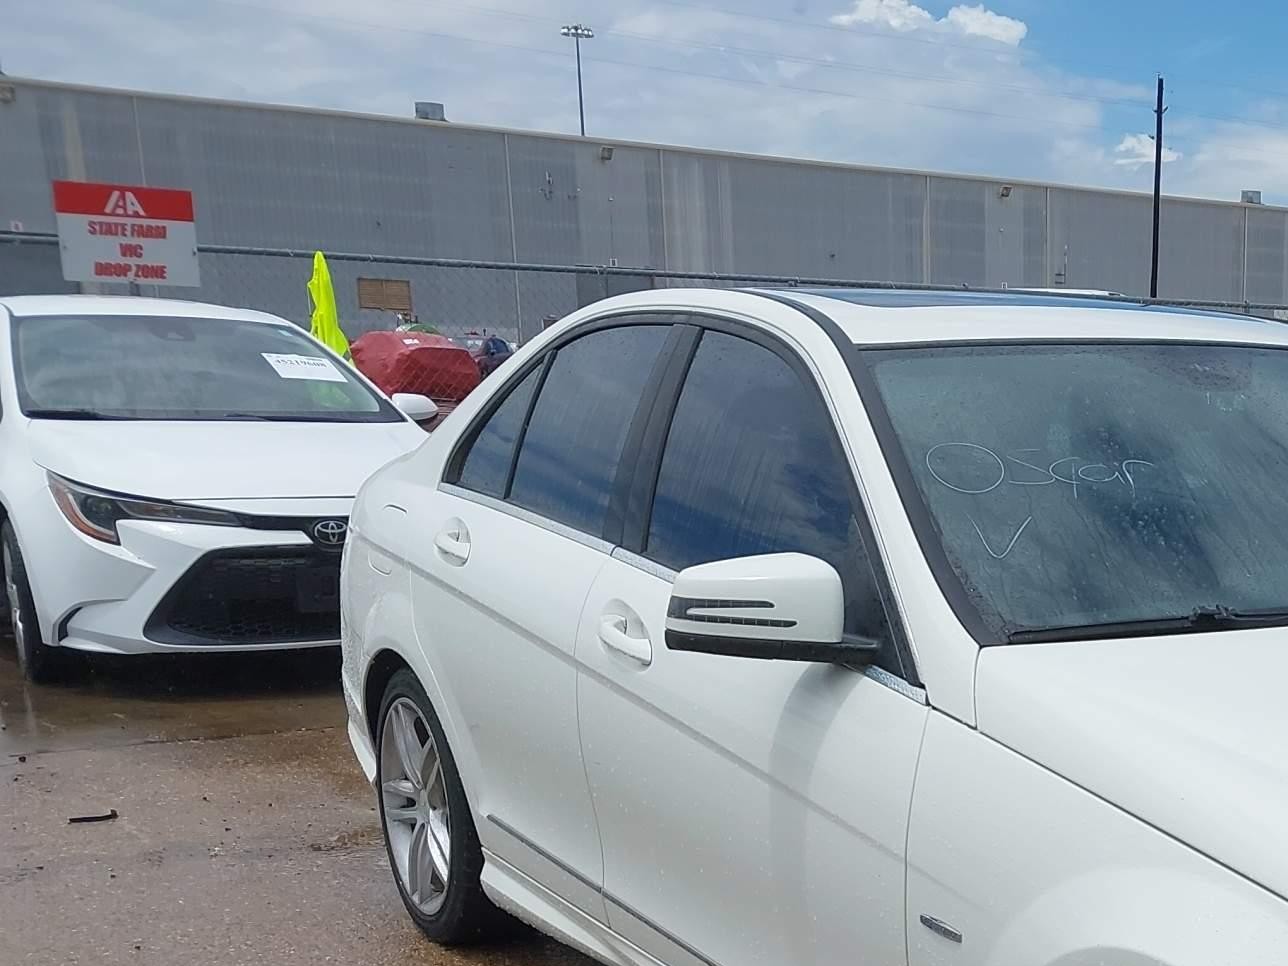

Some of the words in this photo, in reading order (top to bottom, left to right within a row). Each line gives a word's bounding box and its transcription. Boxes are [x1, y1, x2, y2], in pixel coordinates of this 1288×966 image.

[88, 221, 127, 237] STATE
[131, 223, 167, 239] FARM
[94, 262, 132, 277] DROP
[134, 264, 168, 279] ZONE
